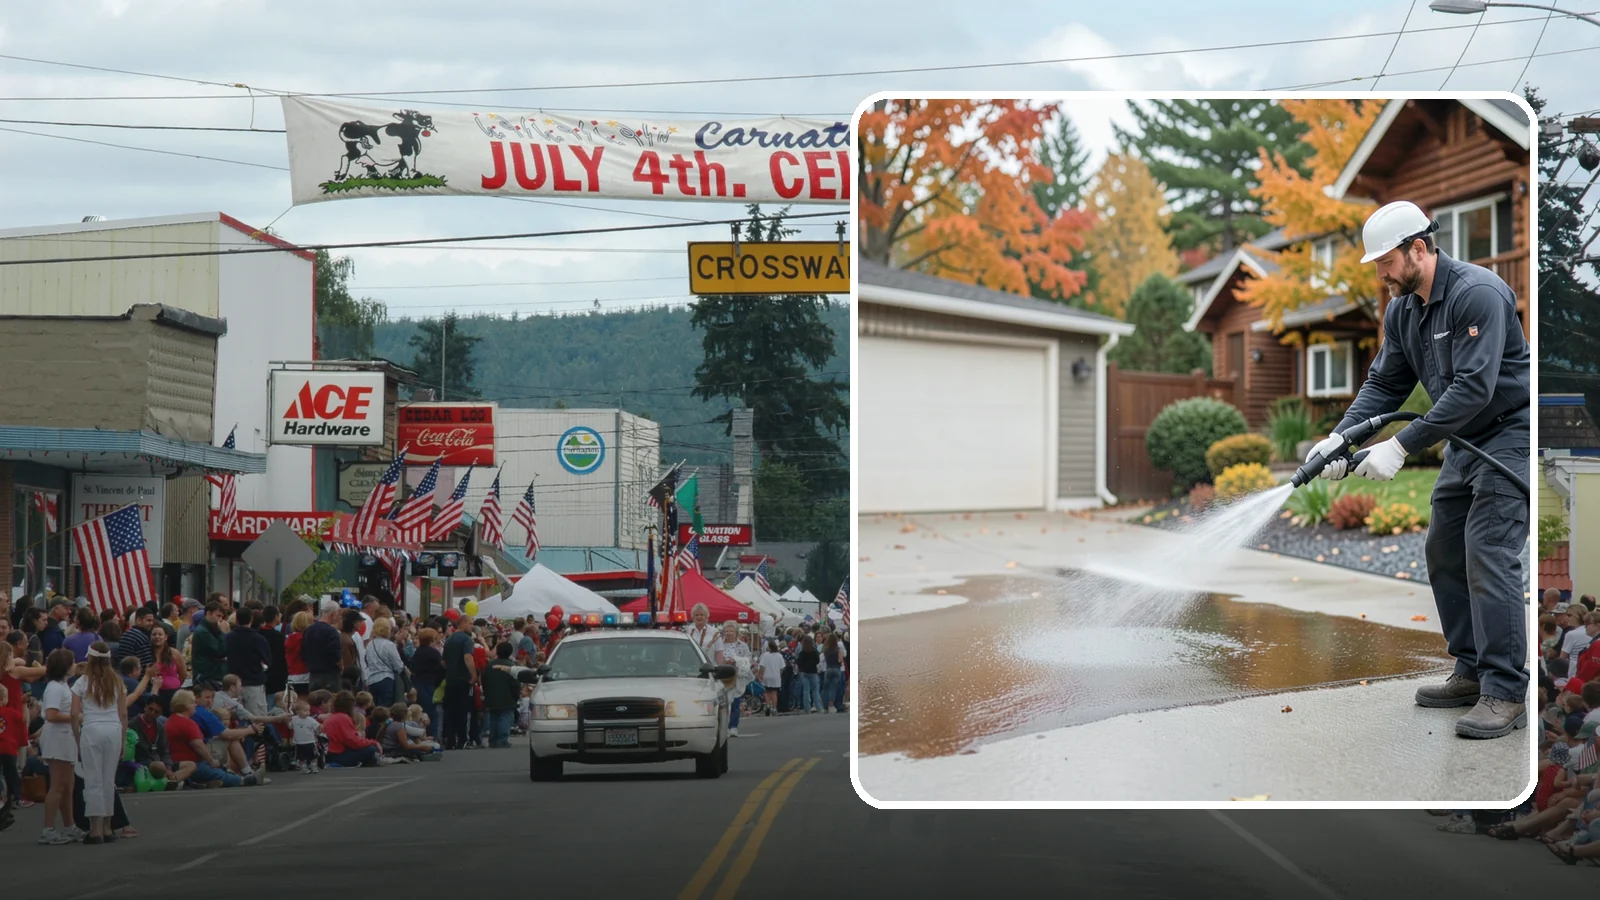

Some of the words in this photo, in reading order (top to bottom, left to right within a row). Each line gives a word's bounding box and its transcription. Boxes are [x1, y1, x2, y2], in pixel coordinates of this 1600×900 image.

[481, 141, 605, 192] JULY
[632, 149, 746, 198] 4th.
[697, 254, 850, 280] CROSSWA
[282, 380, 373, 420] ACE
[405, 409, 453, 422] CEDAR
[283, 421, 371, 436] Hardware
[416, 428, 477, 447] Coca-Cola
[83, 486, 94, 494] St.
[96, 485, 124, 495] Vincent
[126, 486, 136, 495] de
[138, 487, 155, 495] Paul
[700, 535, 730, 543] GLASS
